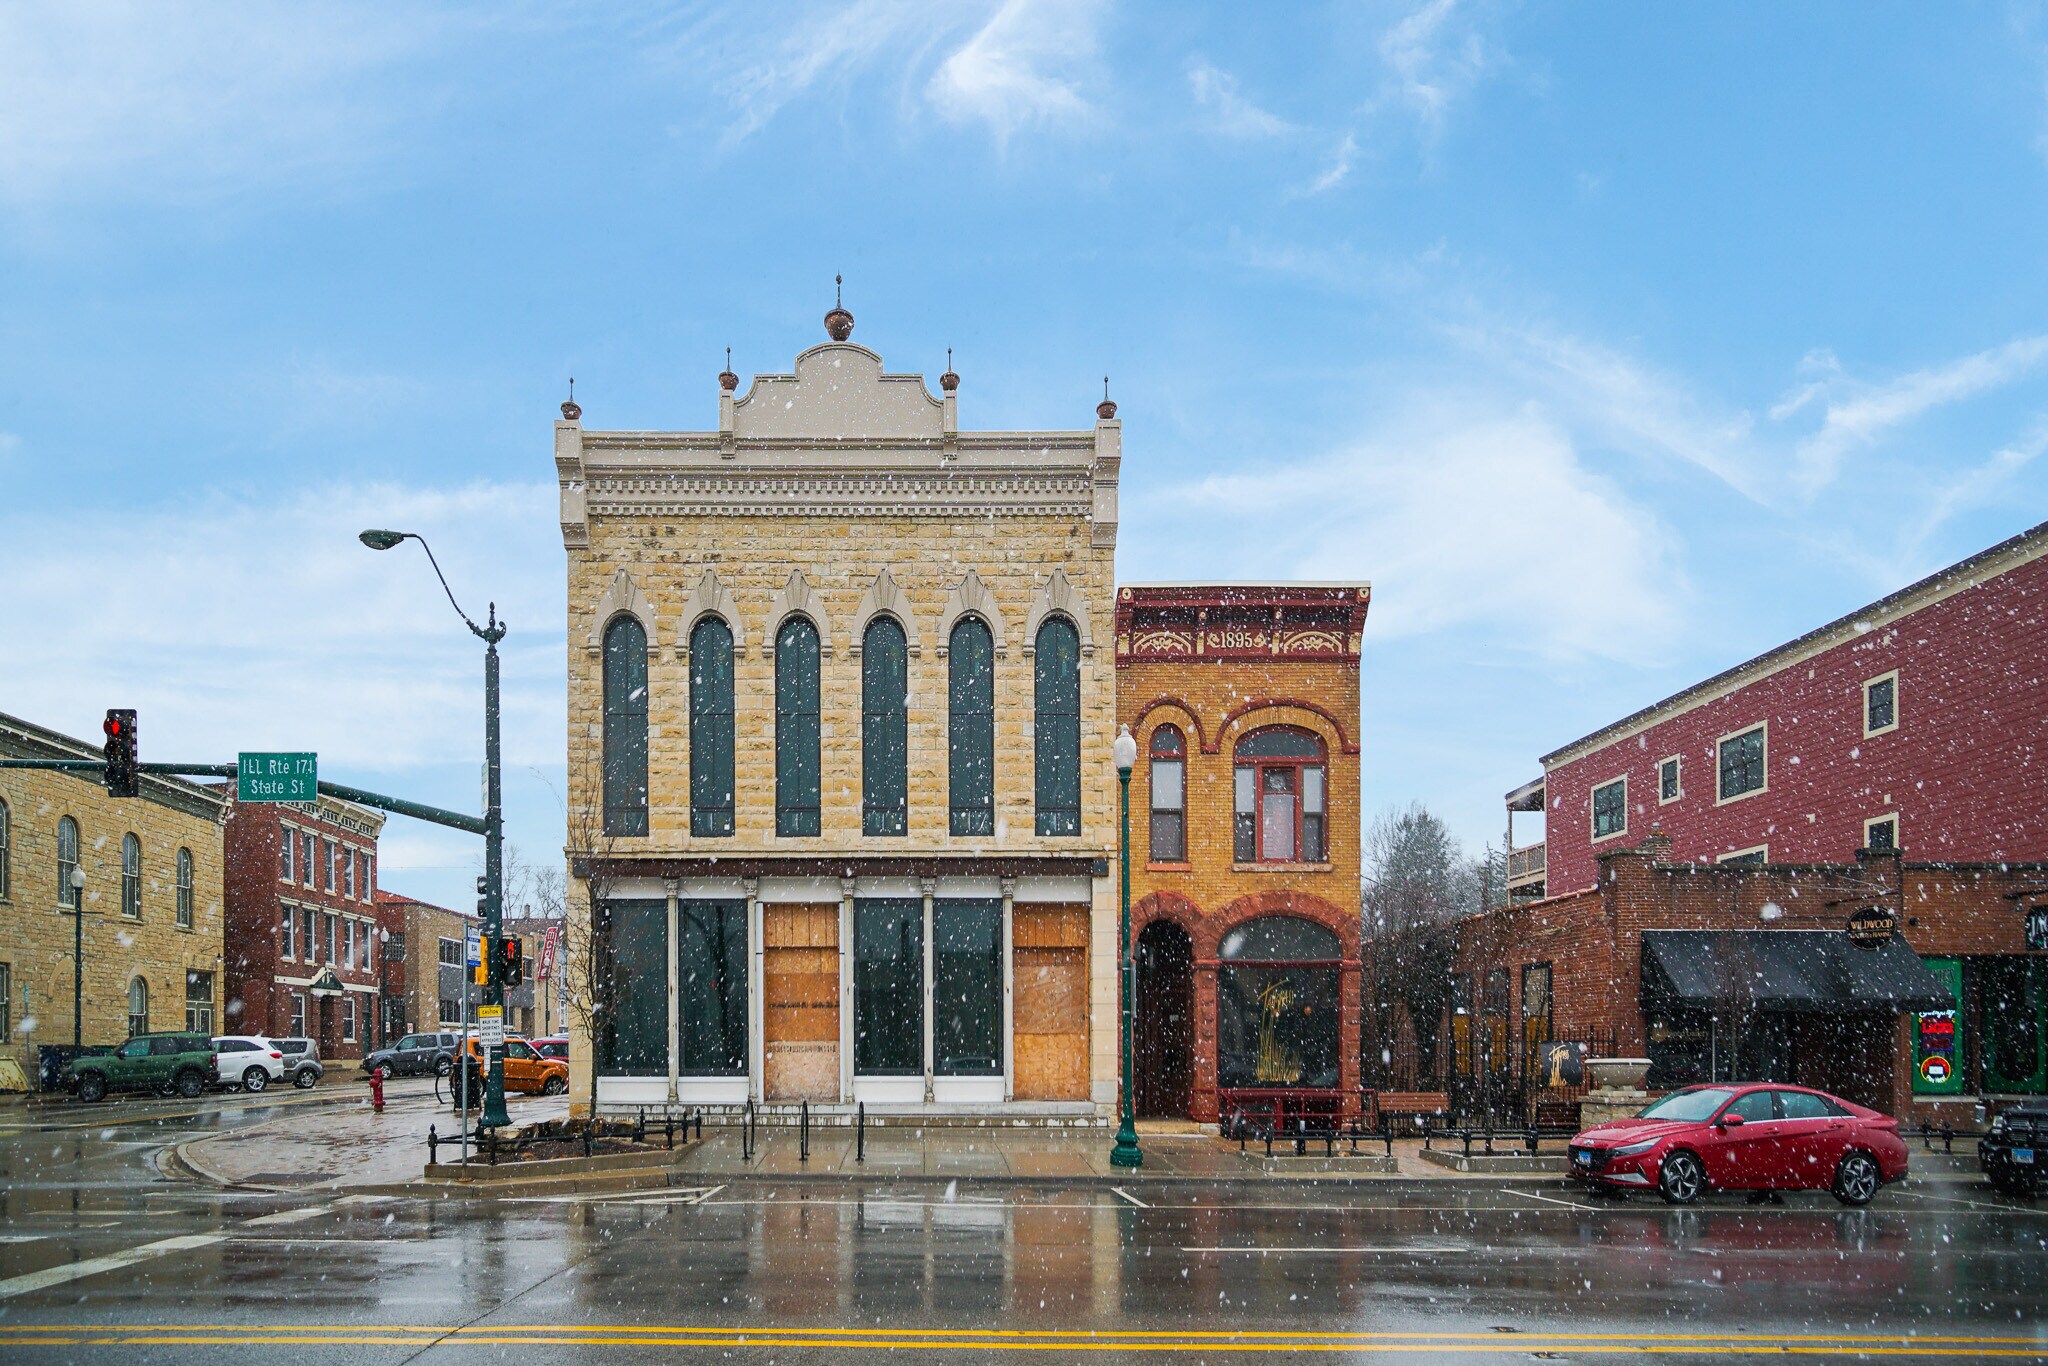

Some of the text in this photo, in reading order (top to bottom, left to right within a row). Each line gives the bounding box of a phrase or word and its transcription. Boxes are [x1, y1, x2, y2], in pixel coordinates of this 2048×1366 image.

[1220, 631, 1253, 648] 1895
[243, 759, 313, 775] ILL Rte 171
[251, 779, 304, 794] State St
[1850, 918, 1893, 930] WILDWOOD
